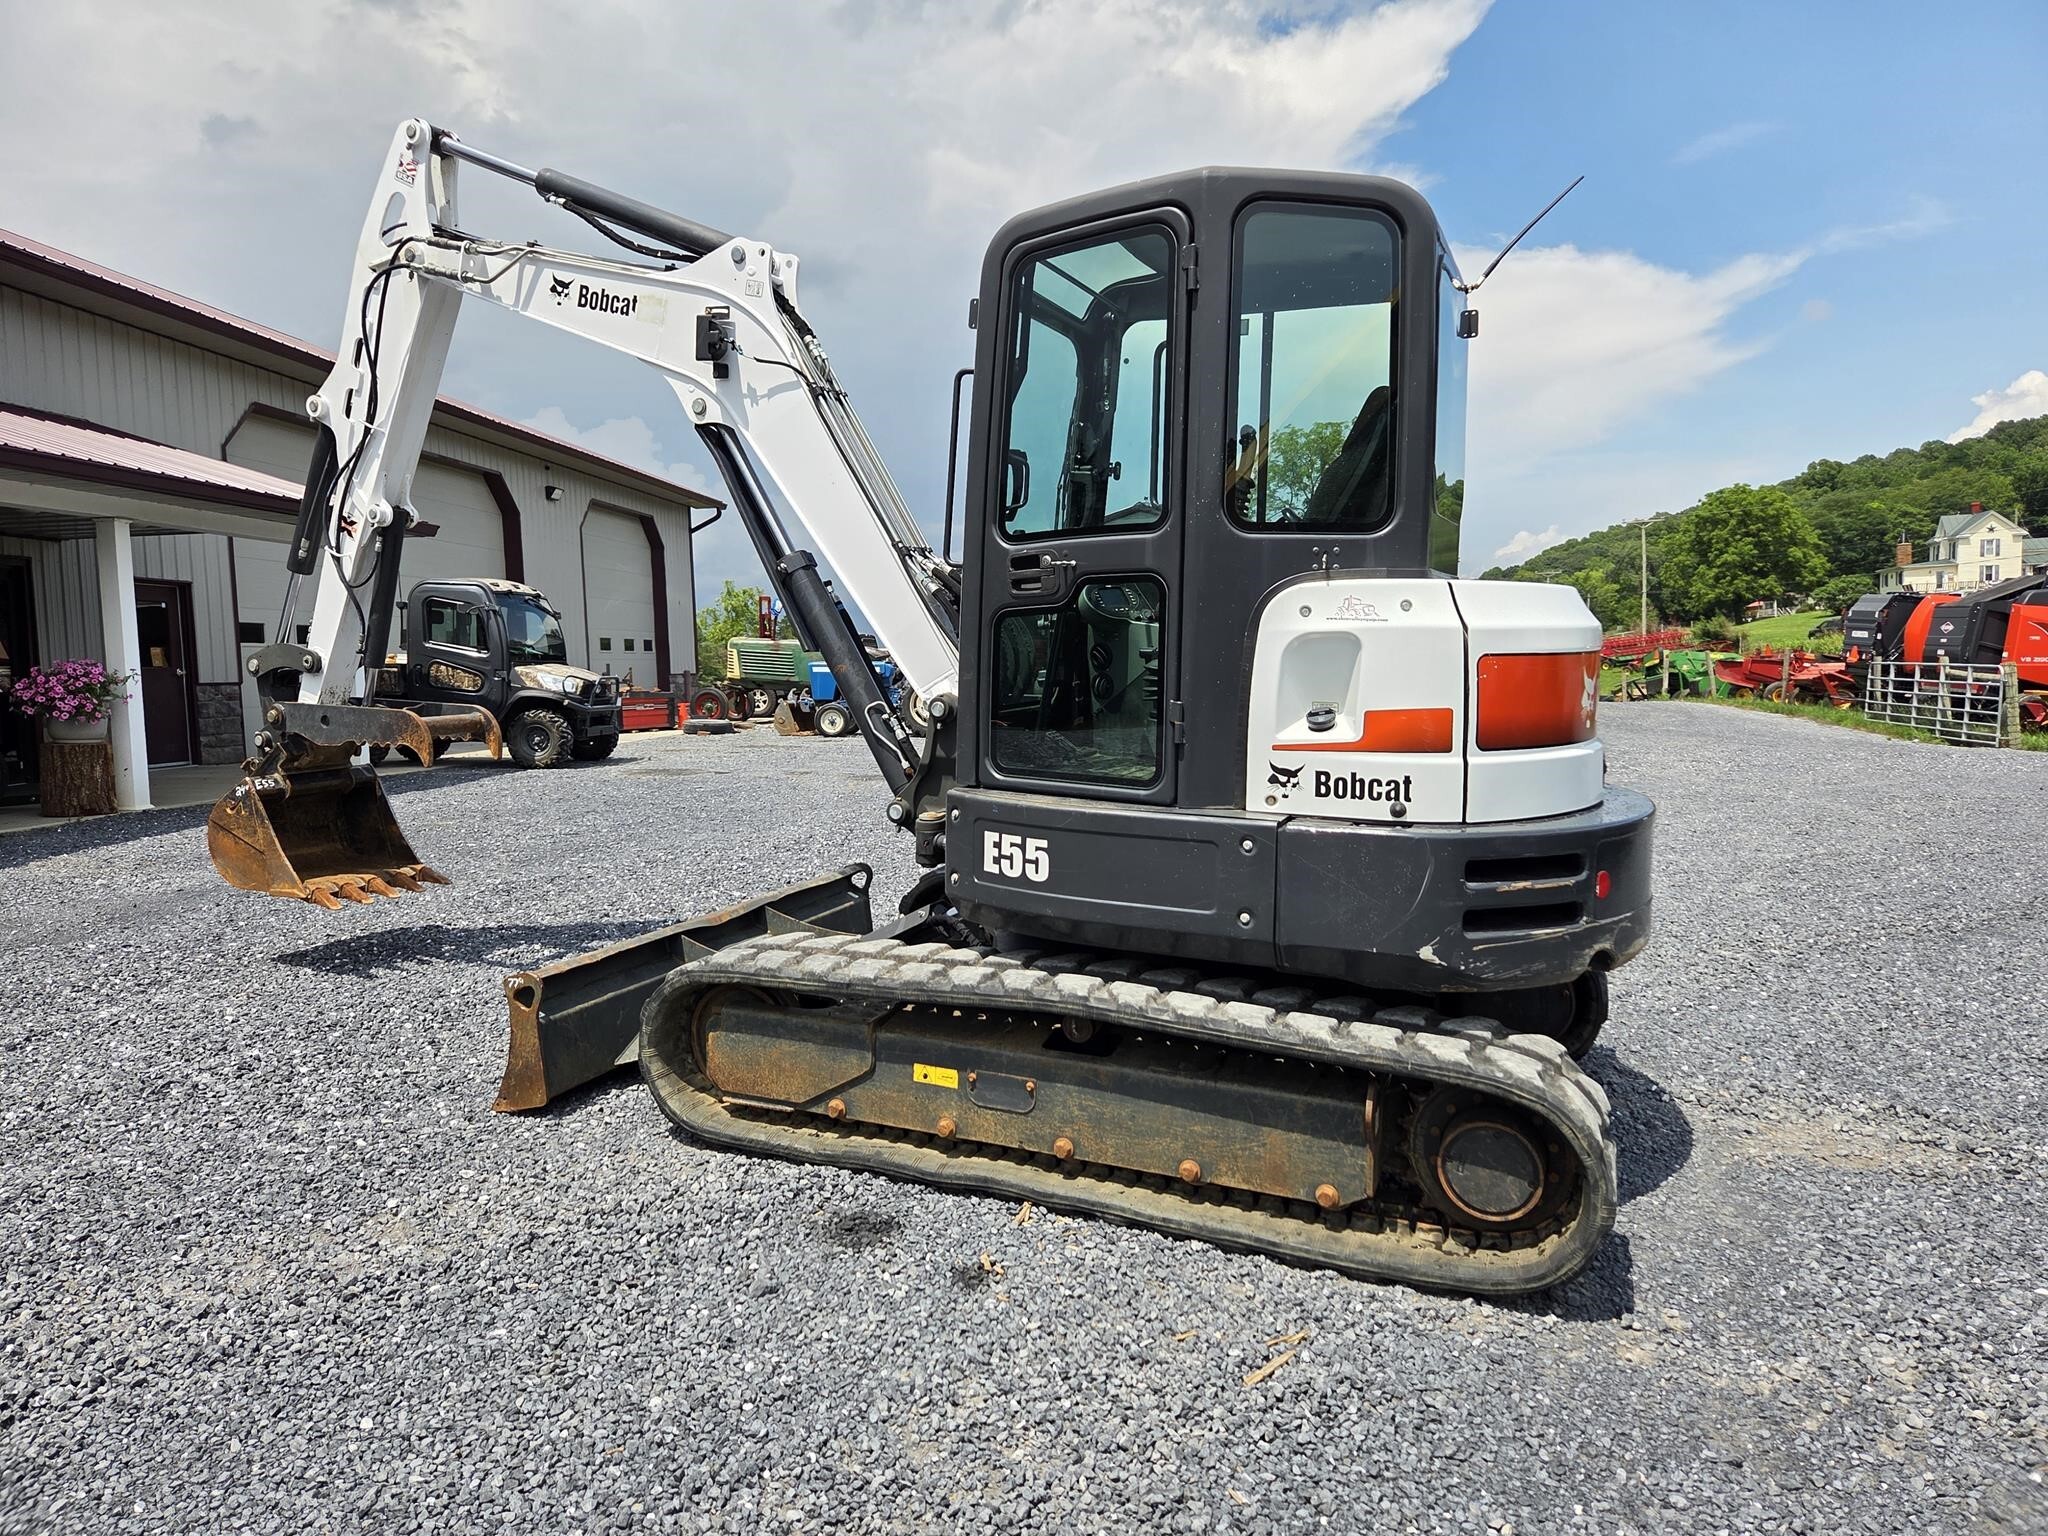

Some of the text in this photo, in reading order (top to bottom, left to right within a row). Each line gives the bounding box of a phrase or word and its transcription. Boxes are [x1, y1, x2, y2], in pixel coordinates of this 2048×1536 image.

[577, 284, 638, 316] Bobcat
[1314, 770, 1412, 803] Bobcat
[984, 830, 1050, 882] E55
